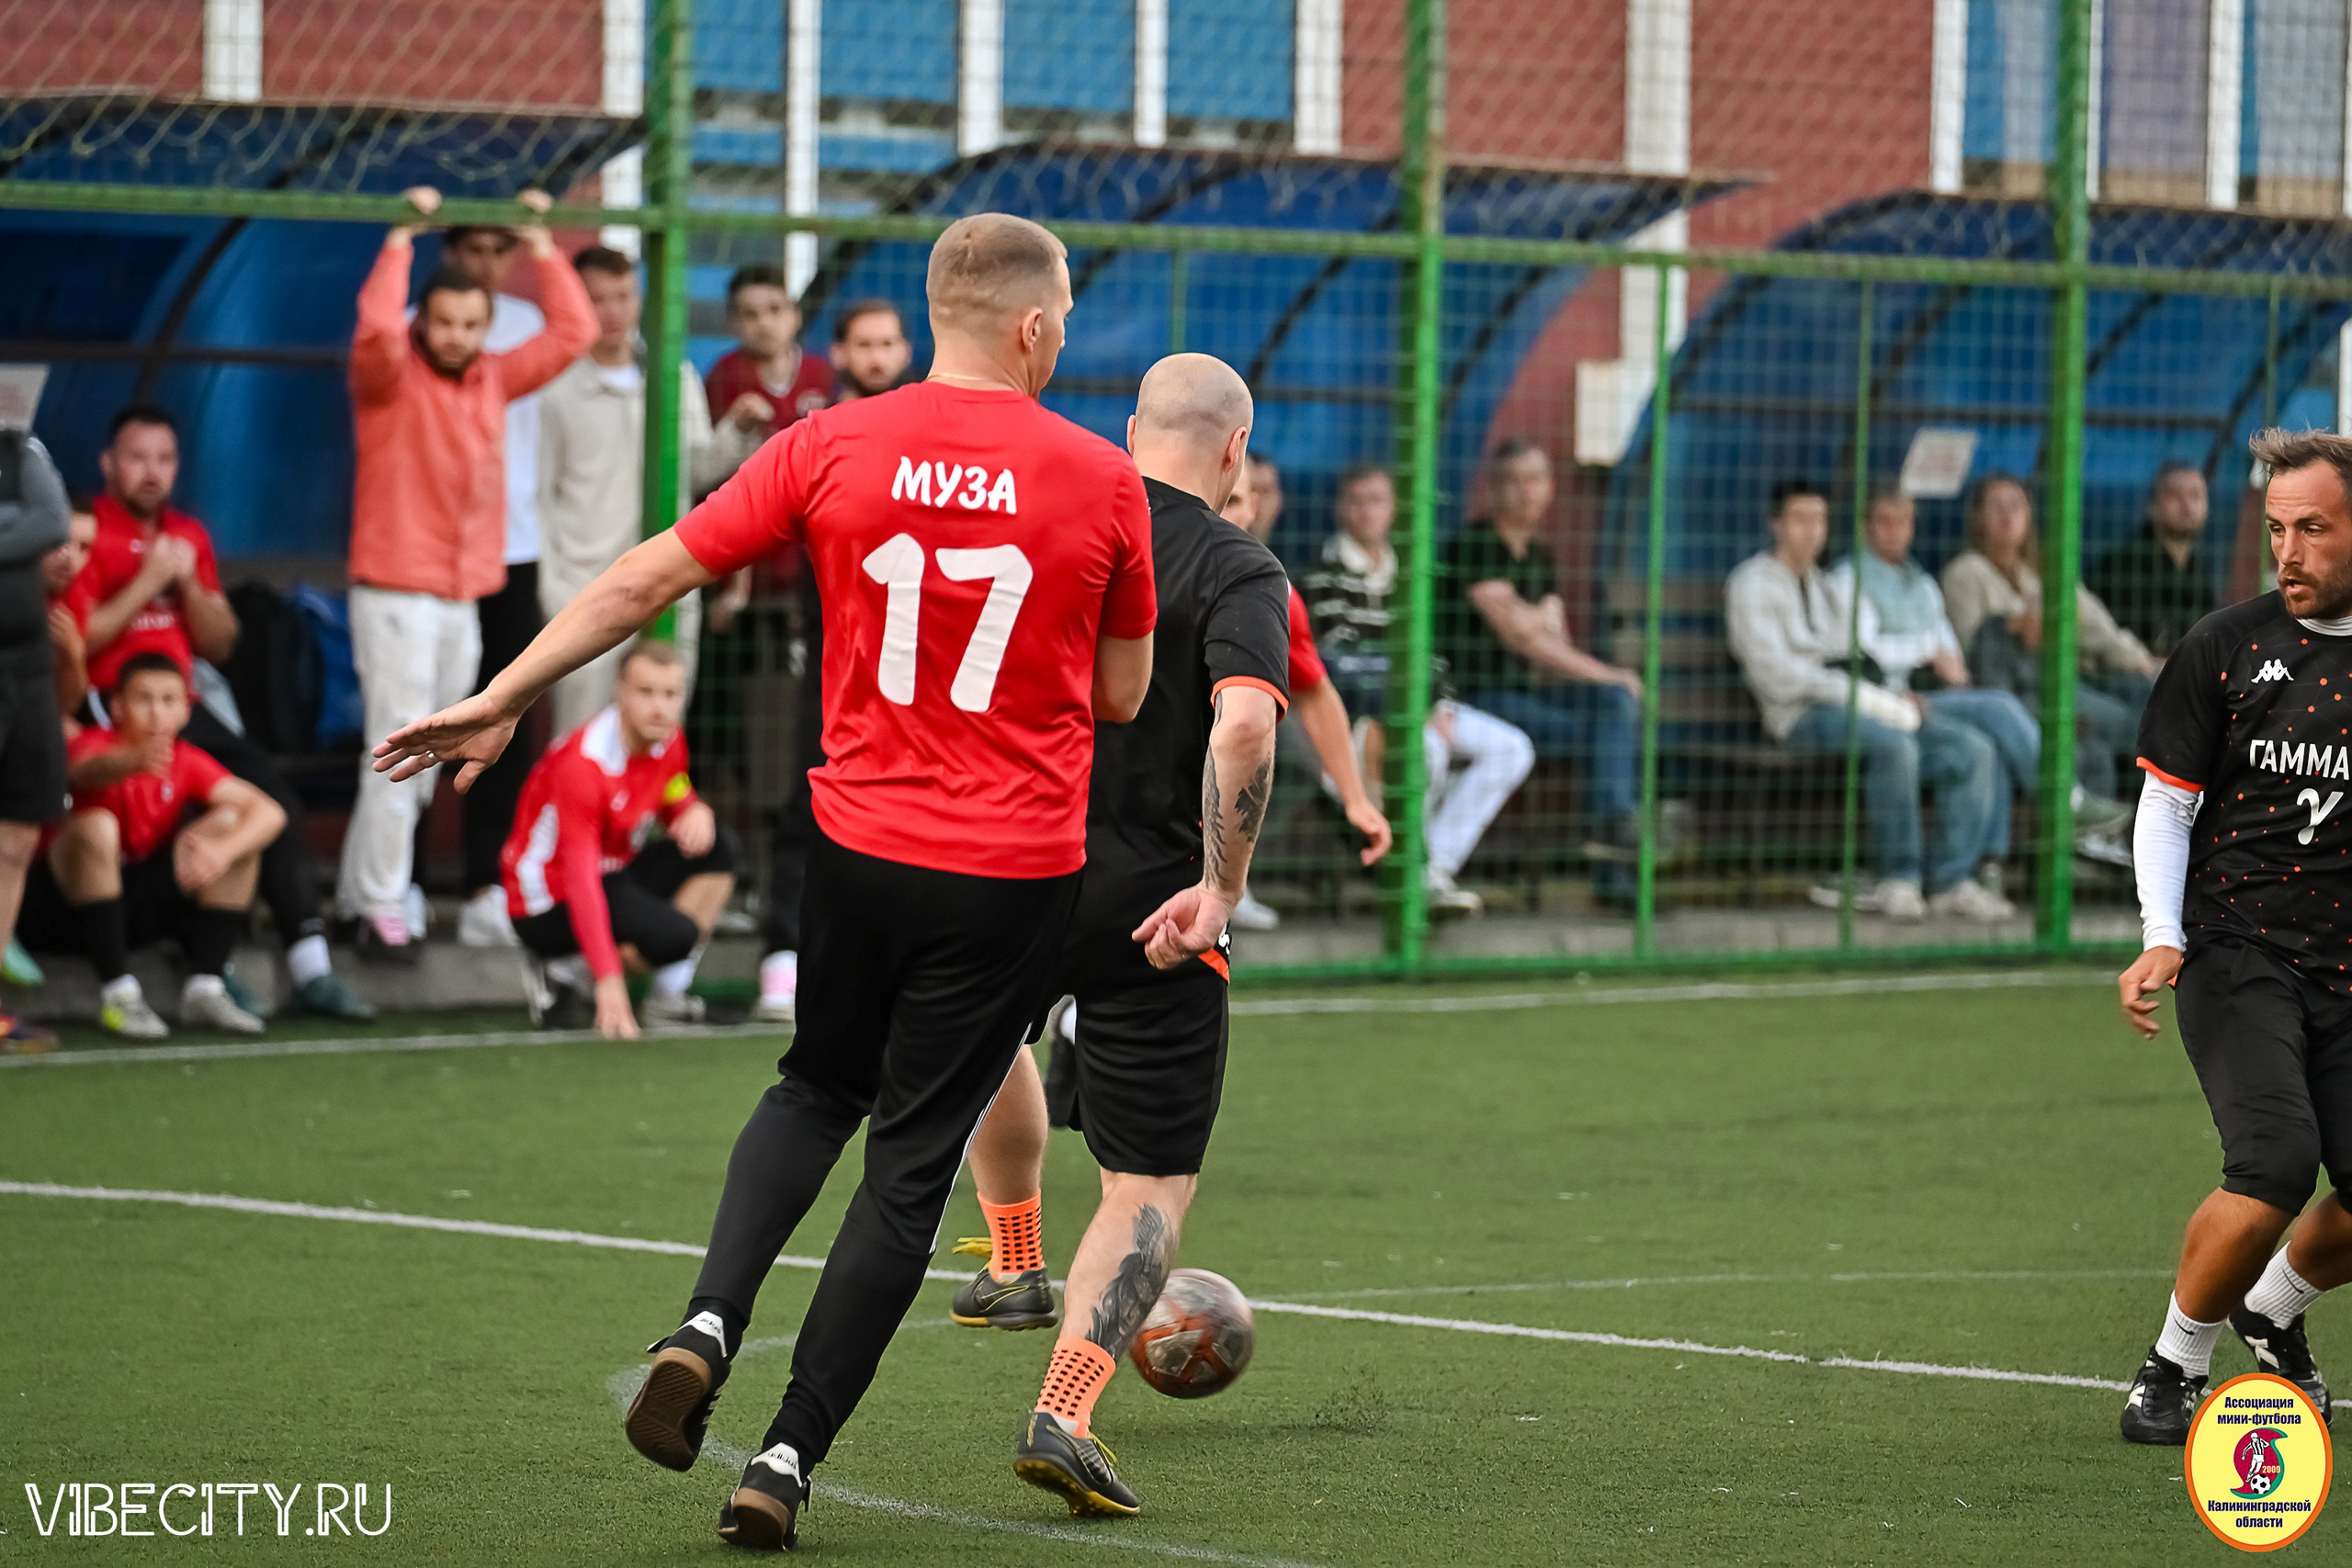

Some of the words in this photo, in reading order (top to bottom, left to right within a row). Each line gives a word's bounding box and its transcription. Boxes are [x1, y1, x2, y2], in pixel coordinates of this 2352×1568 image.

[891, 456, 1017, 514] МУЗА
[862, 533, 1034, 713] 17
[2249, 739, 2350, 781] ГАММА
